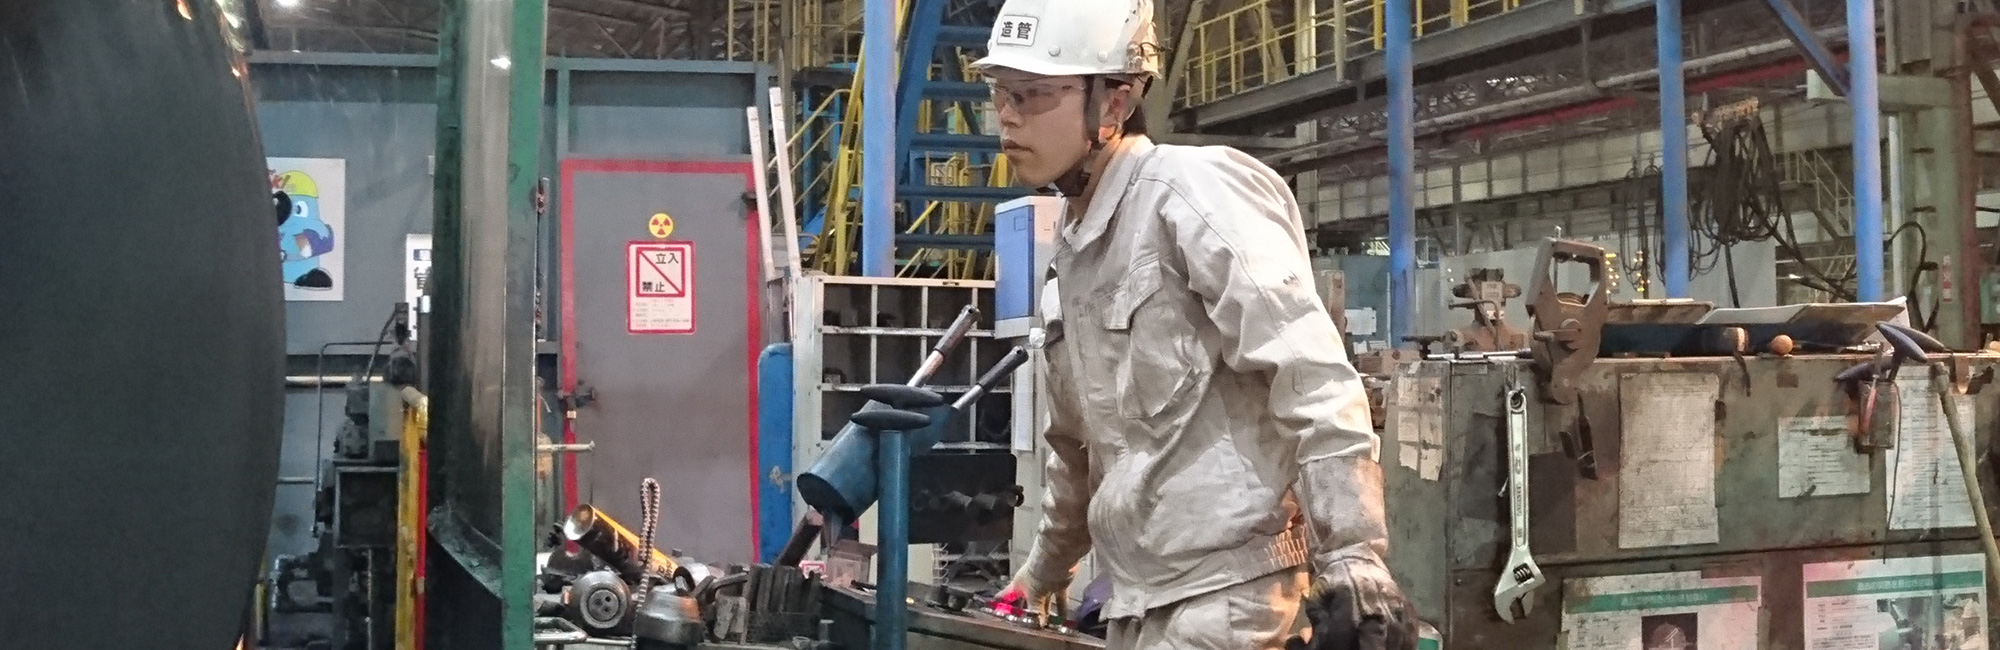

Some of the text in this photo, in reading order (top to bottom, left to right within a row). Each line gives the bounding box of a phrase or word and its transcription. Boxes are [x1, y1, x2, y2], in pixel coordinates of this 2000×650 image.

[1000, 21, 1032, 40] 造管
[655, 253, 679, 265] 立入
[642, 281, 665, 293] 禁止
